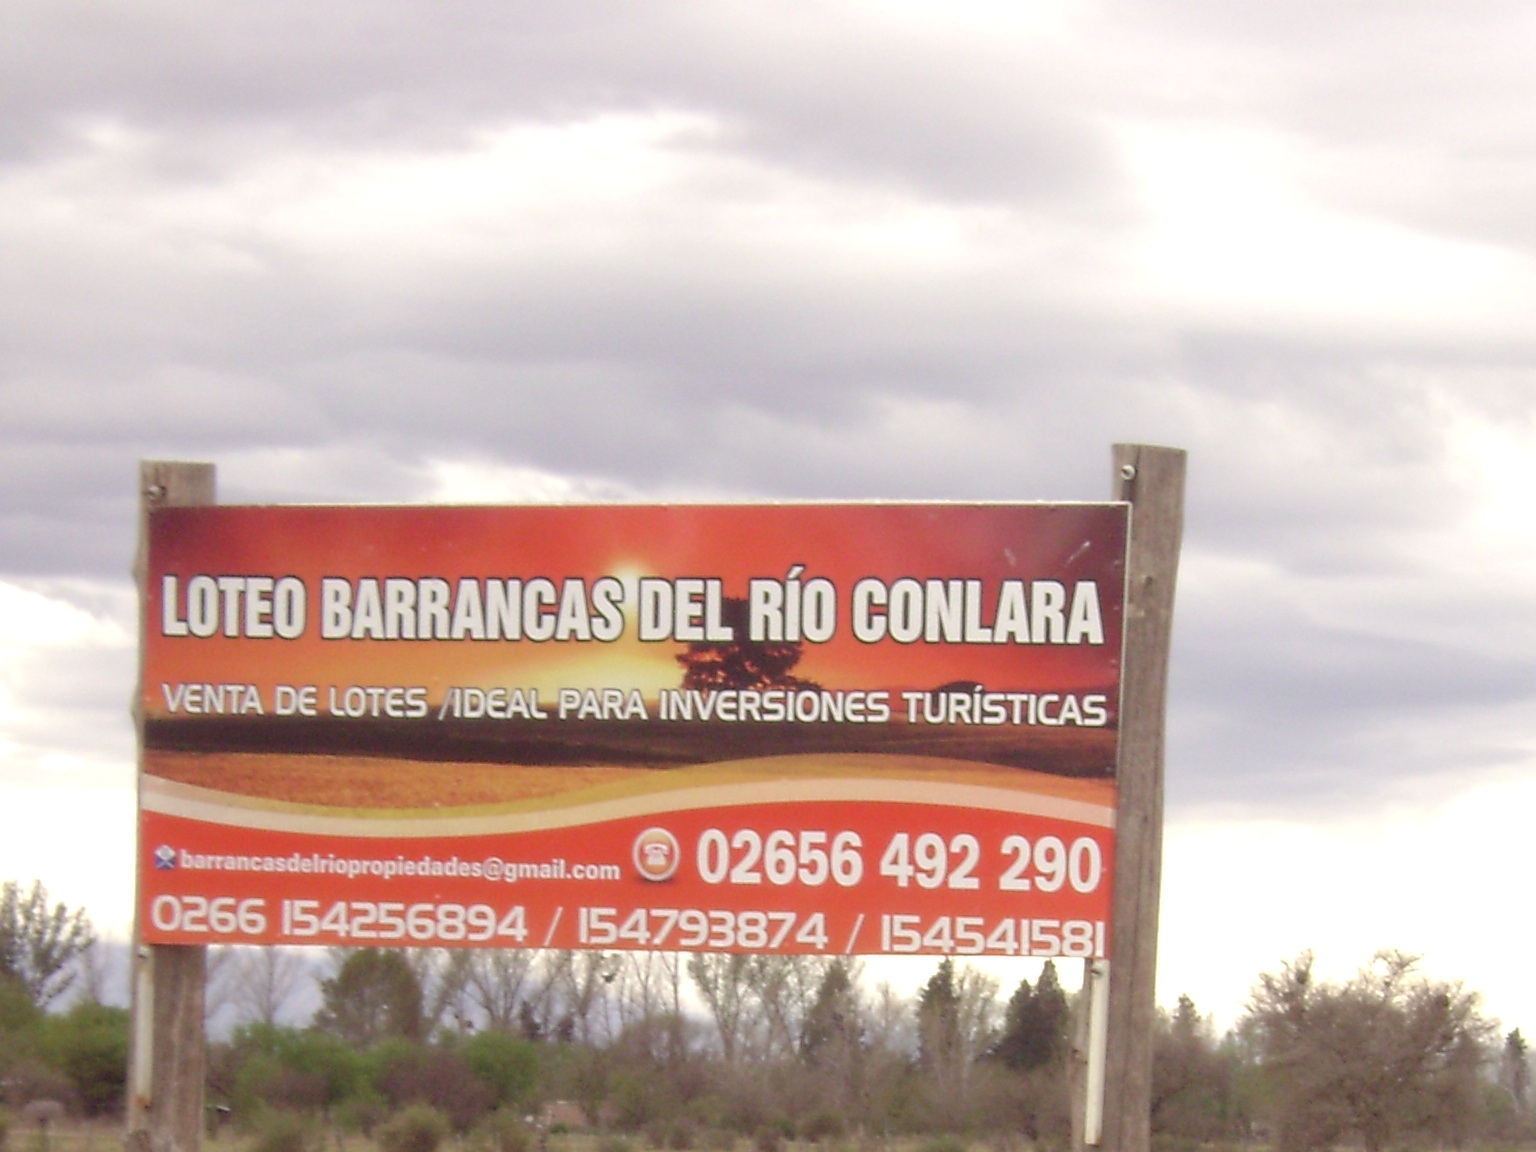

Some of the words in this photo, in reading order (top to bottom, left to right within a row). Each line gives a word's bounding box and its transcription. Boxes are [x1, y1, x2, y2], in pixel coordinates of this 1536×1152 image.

[162, 574, 306, 639] LOTEO
[320, 576, 625, 642] BARRANCAS
[638, 577, 734, 642] DEL
[749, 565, 837, 643] RÍO
[852, 577, 1104, 645] CONLARA
[162, 683, 264, 715] VENTA
[276, 686, 317, 717] DE
[330, 686, 428, 718] LOTES
[559, 689, 648, 721] PARA
[660, 689, 889, 723] INVERSIONES
[903, 685, 1107, 727] TURÍSTICAS
[180, 849, 621, 882] barrancasdelriopropiedades@gmail.com
[697, 828, 863, 886] 02656
[880, 832, 979, 890] 492
[999, 835, 1102, 893] 290
[152, 895, 267, 934] 0266
[282, 900, 528, 943] 154256894
[579, 906, 828, 950] 154793874
[882, 915, 1105, 957] 154541581
